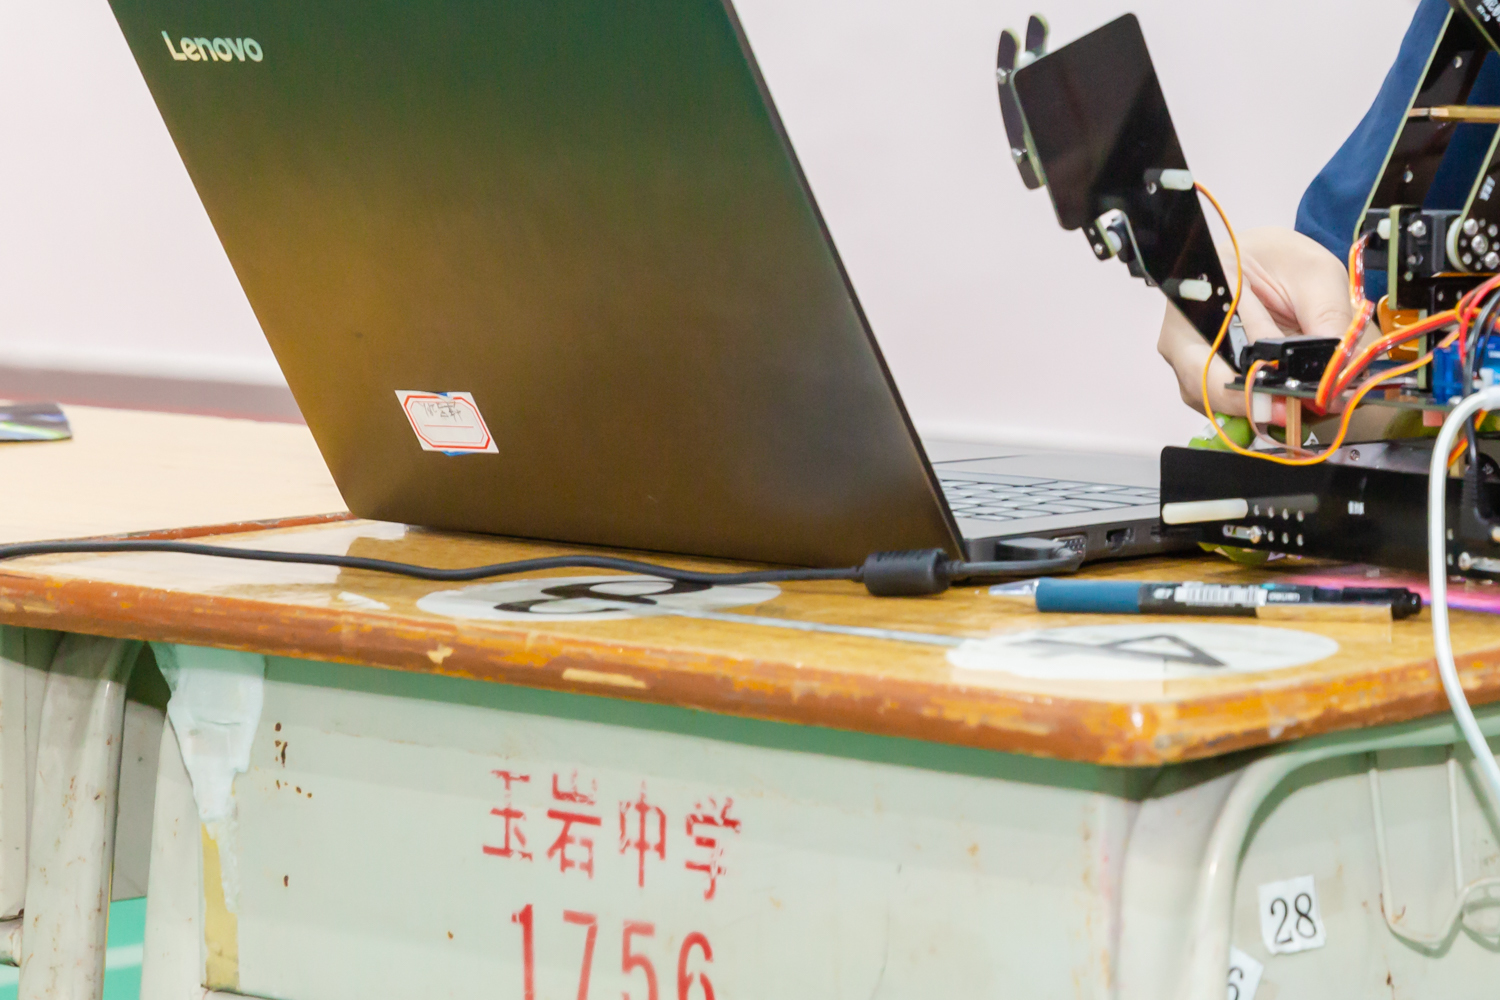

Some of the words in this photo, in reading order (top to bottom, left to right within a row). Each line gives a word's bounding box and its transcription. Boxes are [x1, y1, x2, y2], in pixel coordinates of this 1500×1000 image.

[161, 30, 263, 62] Lenovo
[483, 769, 742, 901] 玉岩中学
[1270, 892, 1317, 945] 28
